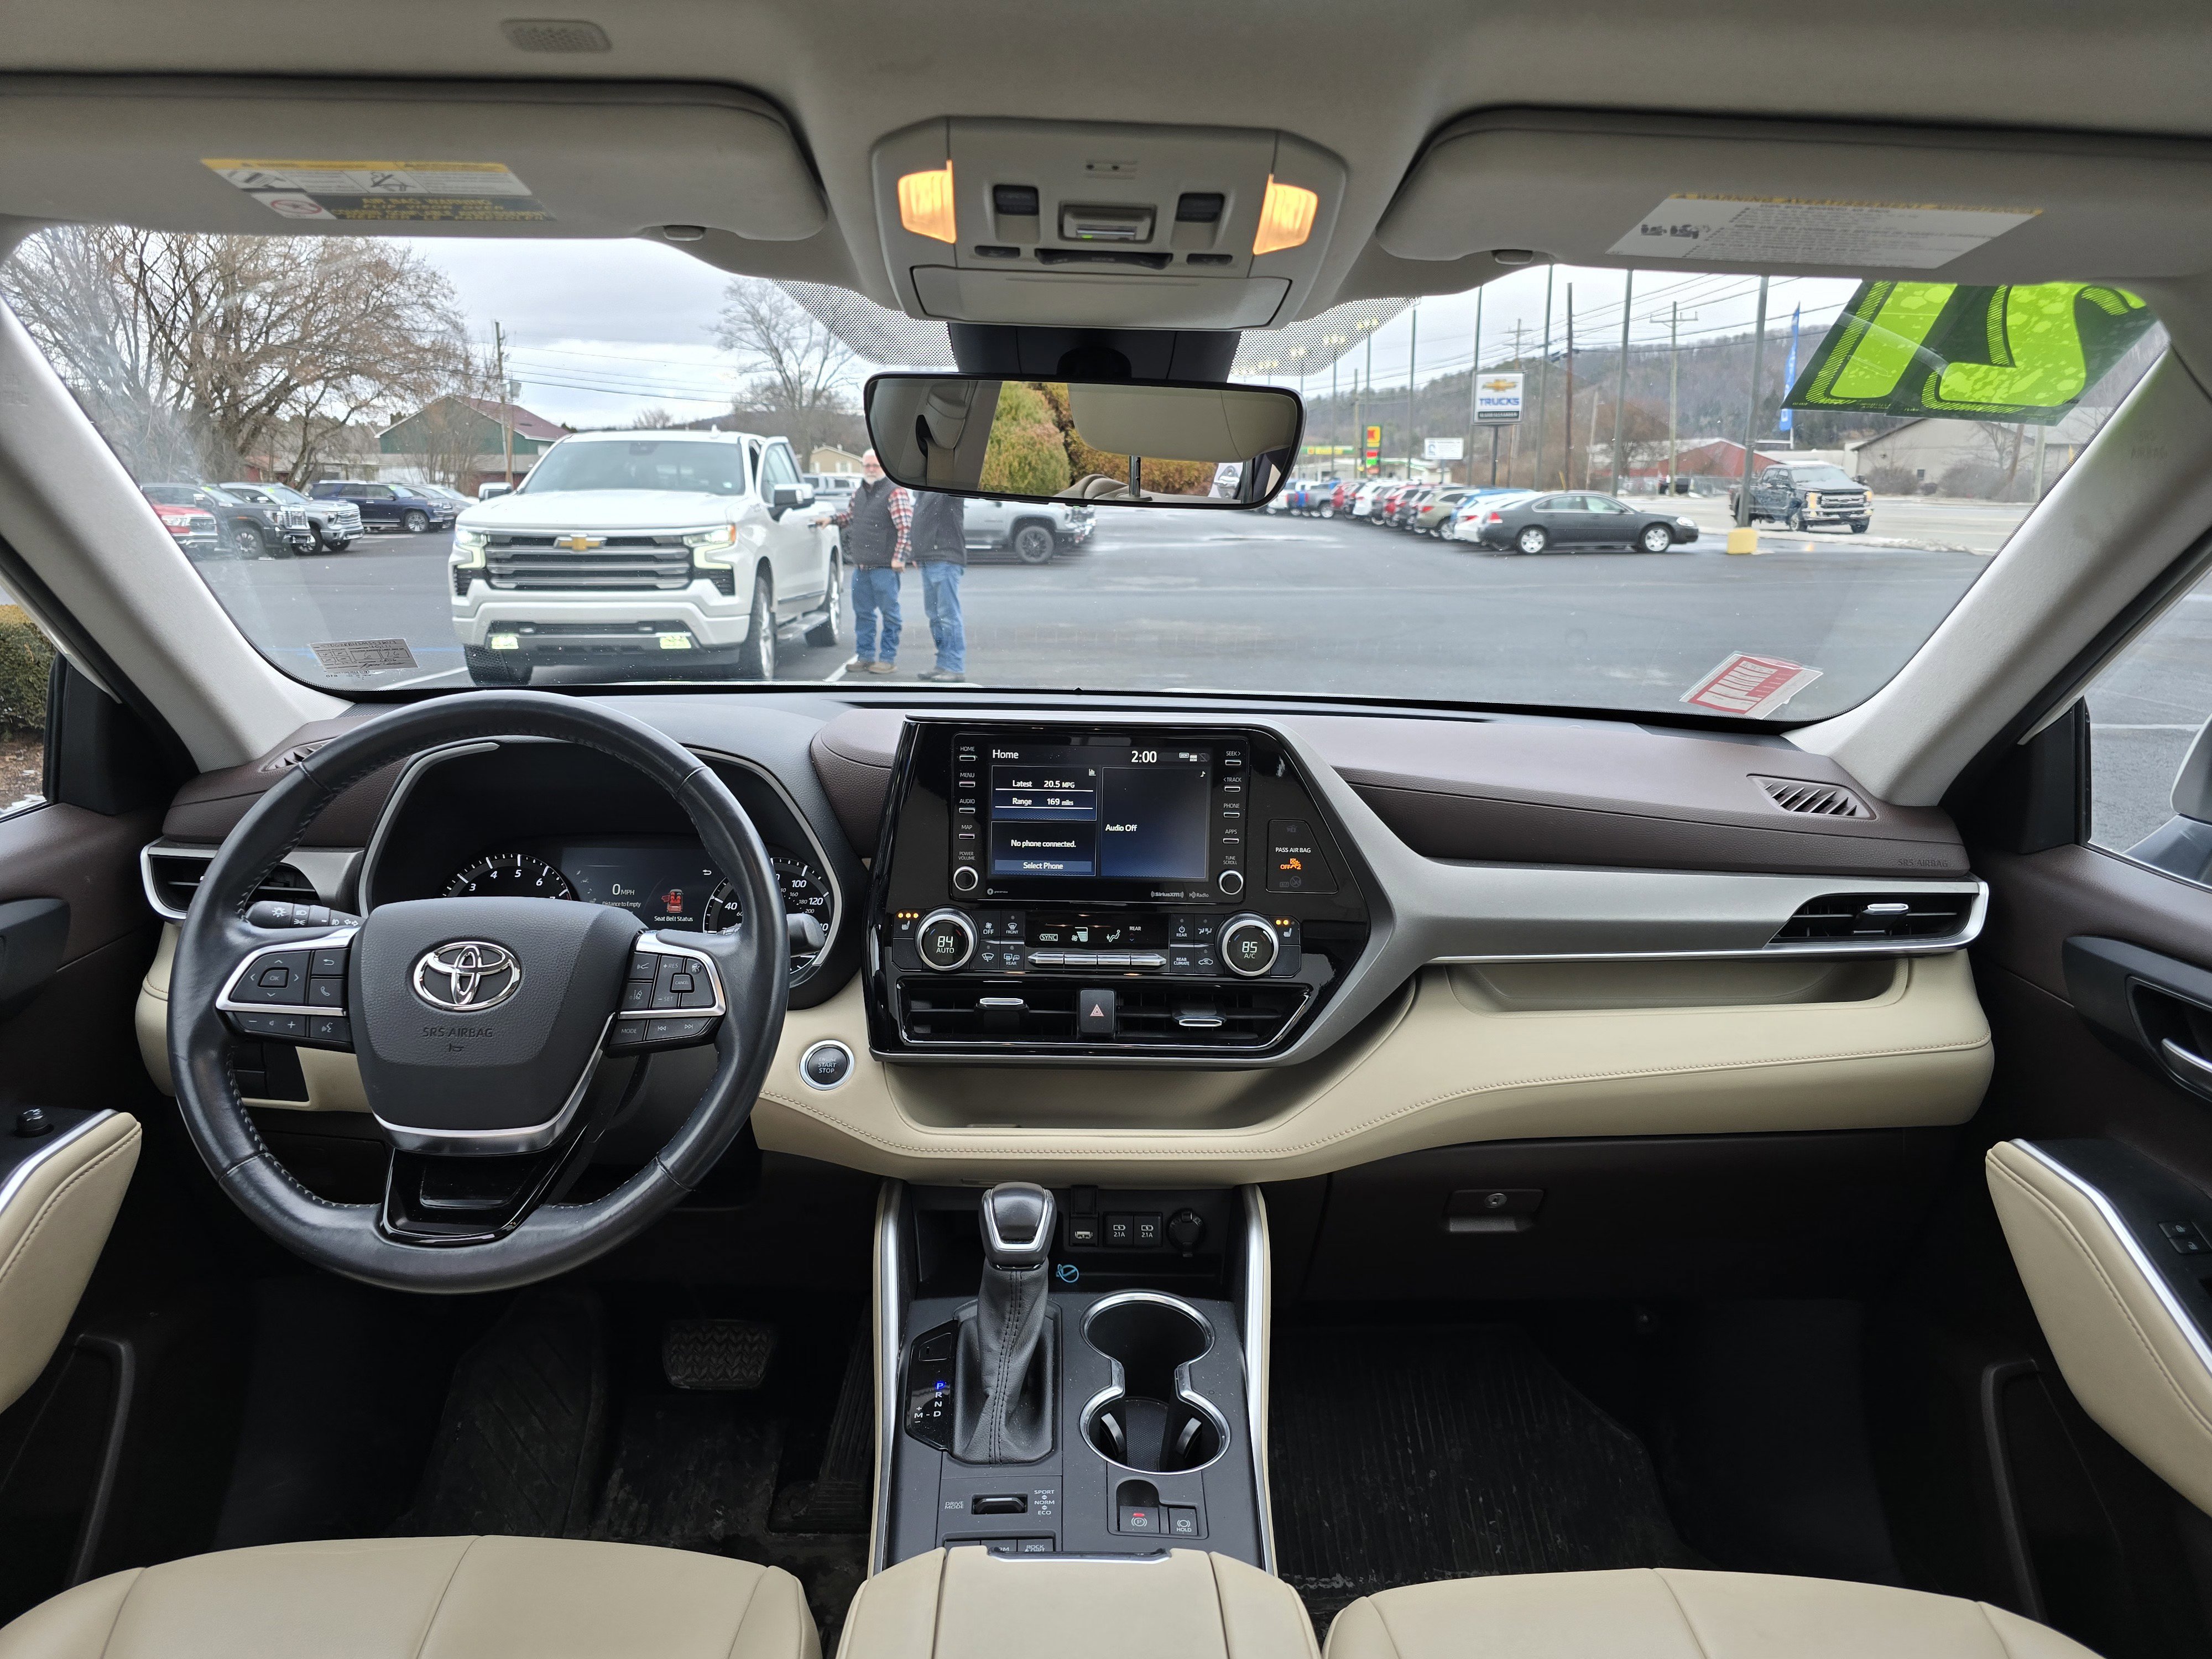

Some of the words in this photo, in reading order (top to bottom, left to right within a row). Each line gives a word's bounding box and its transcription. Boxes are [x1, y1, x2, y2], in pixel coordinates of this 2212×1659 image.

[992, 749, 1019, 759] Home
[1131, 750, 1157, 763] 2:00
[1013, 797, 1032, 806] Range
[612, 884, 620, 895] 0
[937, 936, 953, 947] 84
[1242, 942, 1258, 953] 85
[422, 1027, 445, 1037] SRS
[448, 1027, 493, 1038] AIRBAG
